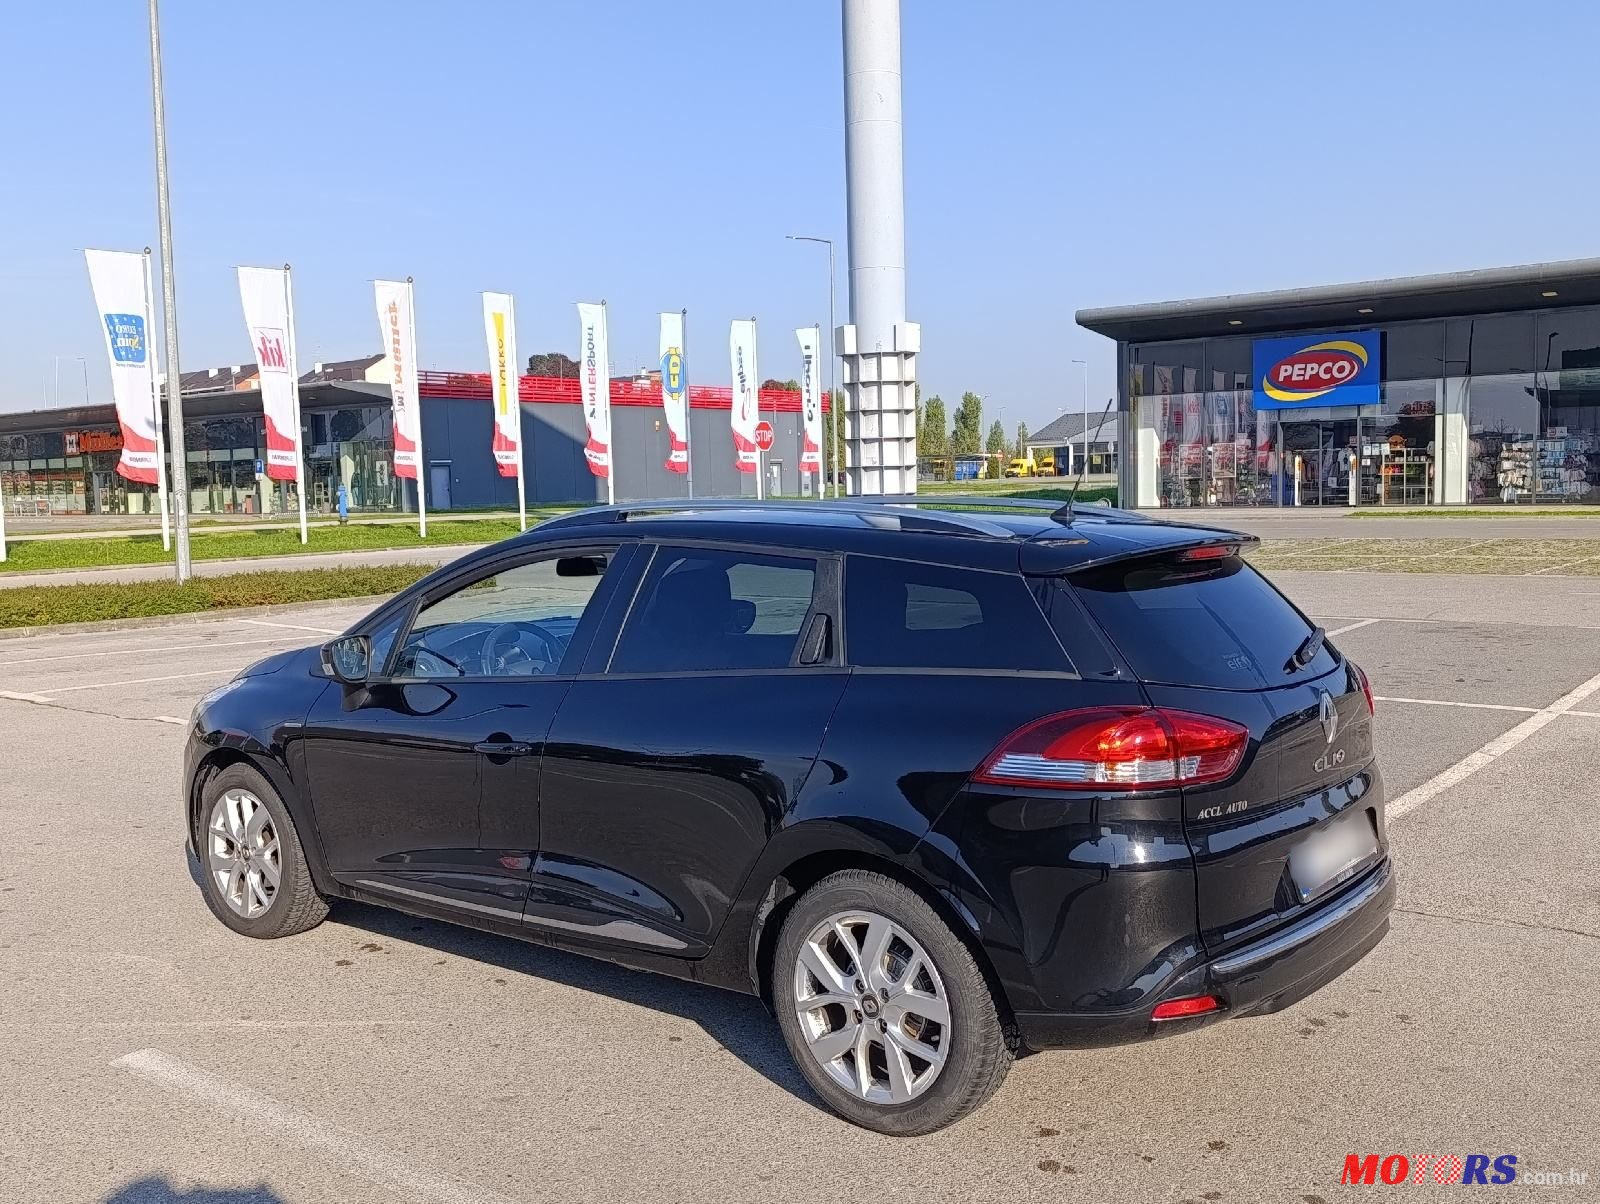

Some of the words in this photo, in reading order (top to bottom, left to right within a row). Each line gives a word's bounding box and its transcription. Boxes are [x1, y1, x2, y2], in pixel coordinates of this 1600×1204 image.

[1278, 360, 1351, 382] PEPCO
[756, 431, 772, 442] STOP
[256, 461, 262, 472] P
[1314, 748, 1345, 773] CLIO
[1226, 800, 1248, 814] AUTO
